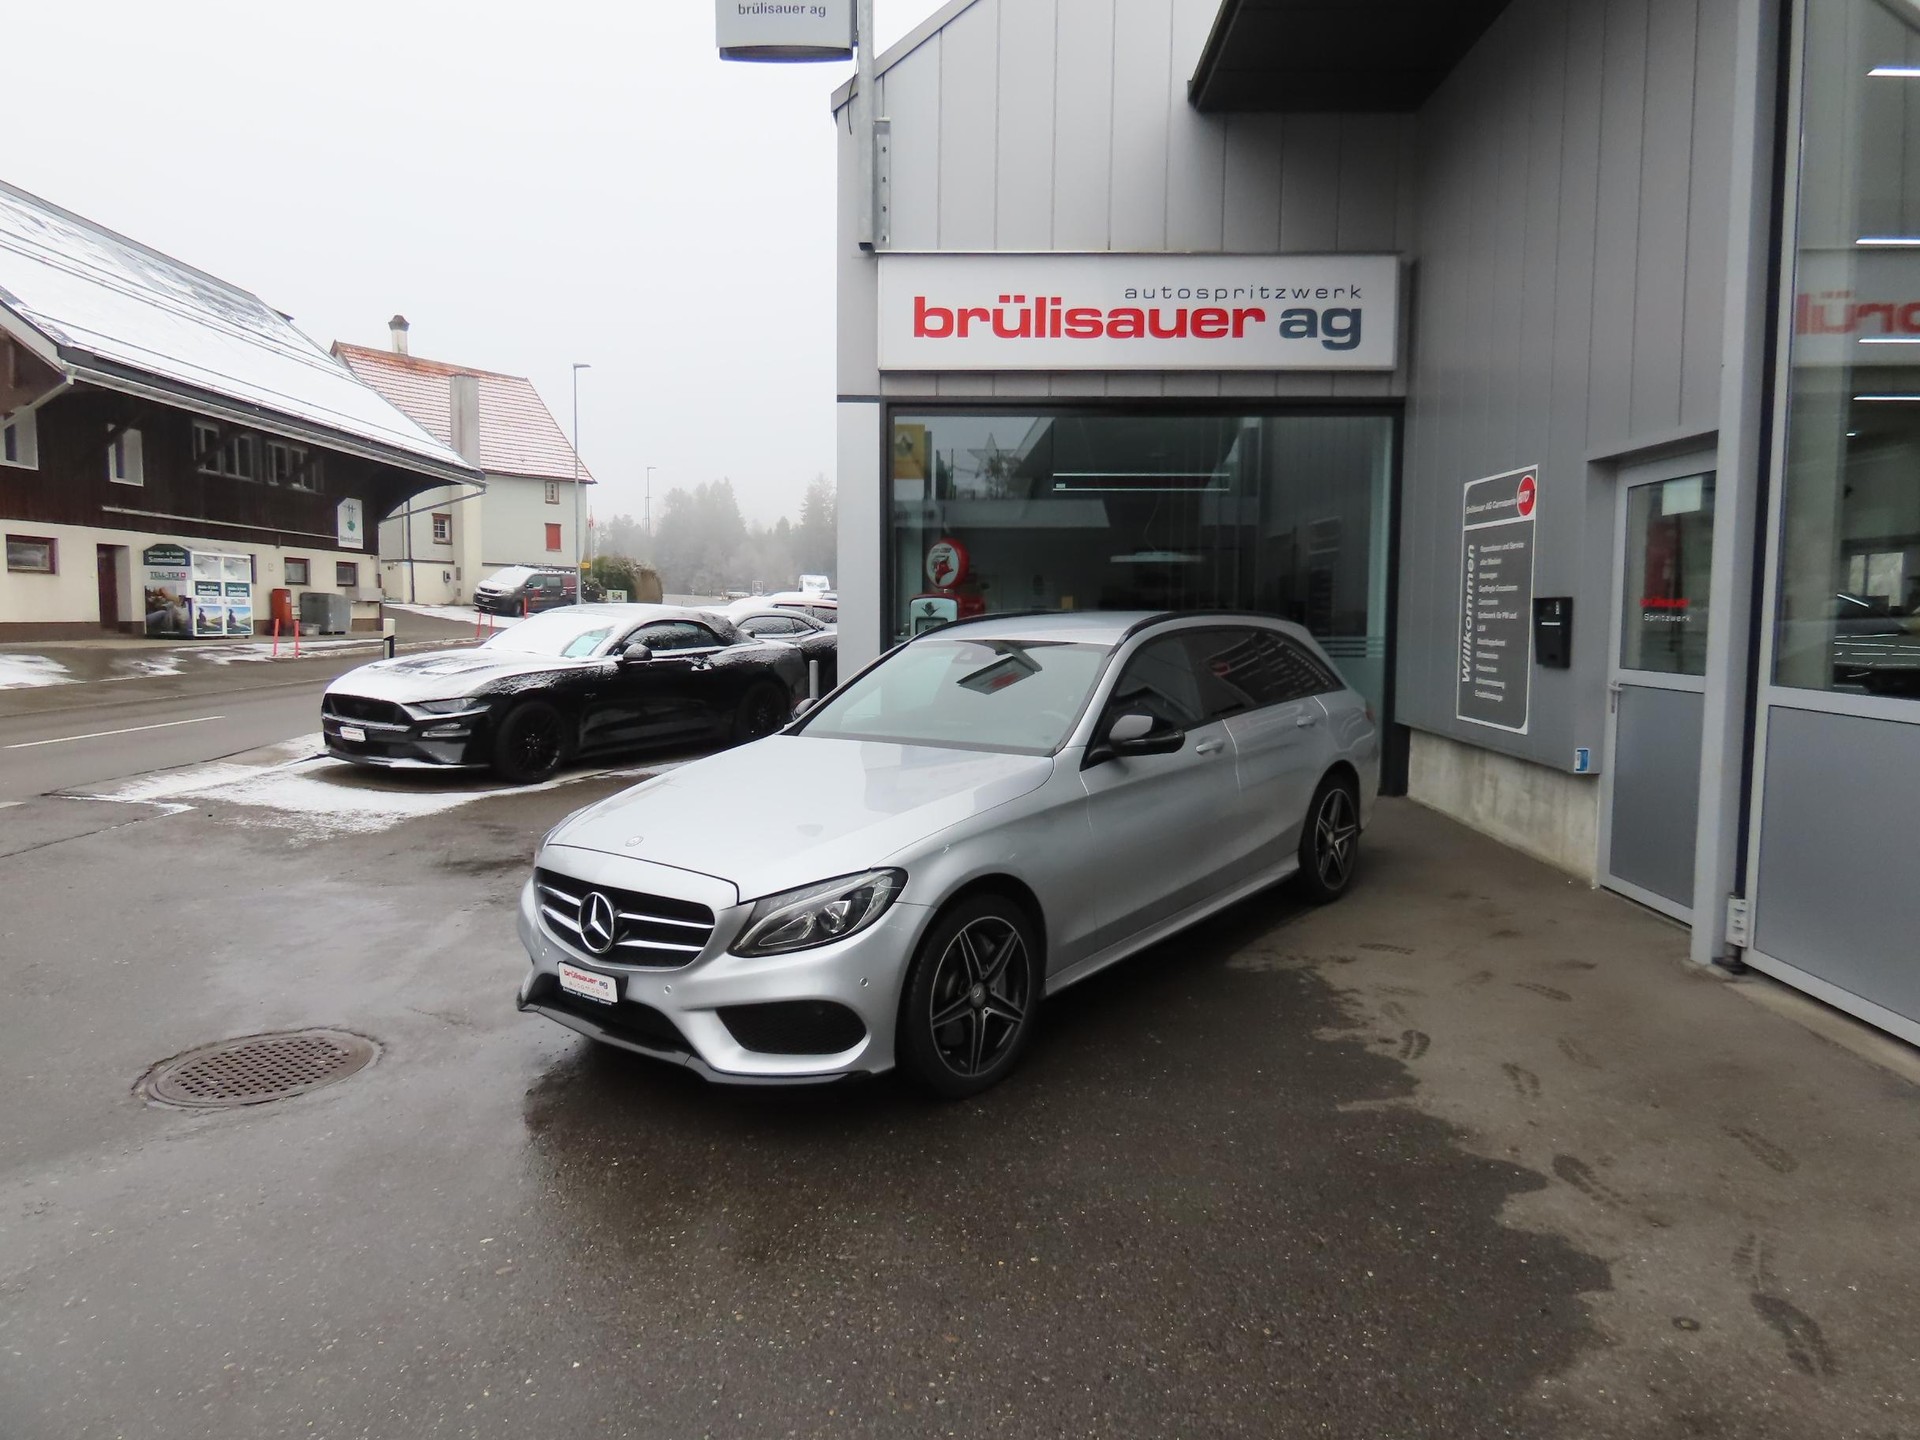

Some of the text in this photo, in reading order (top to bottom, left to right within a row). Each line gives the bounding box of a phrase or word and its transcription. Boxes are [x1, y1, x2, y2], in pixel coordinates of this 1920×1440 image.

[738, 2, 827, 18] brülisauer ag
[1124, 284, 1362, 303] autospritzwerk
[914, 294, 1363, 351] brülisauer ag
[1461, 544, 1475, 682] Willkommen
[1643, 613, 1692, 623] Spritzwerk
[598, 980, 609, 990] ag
